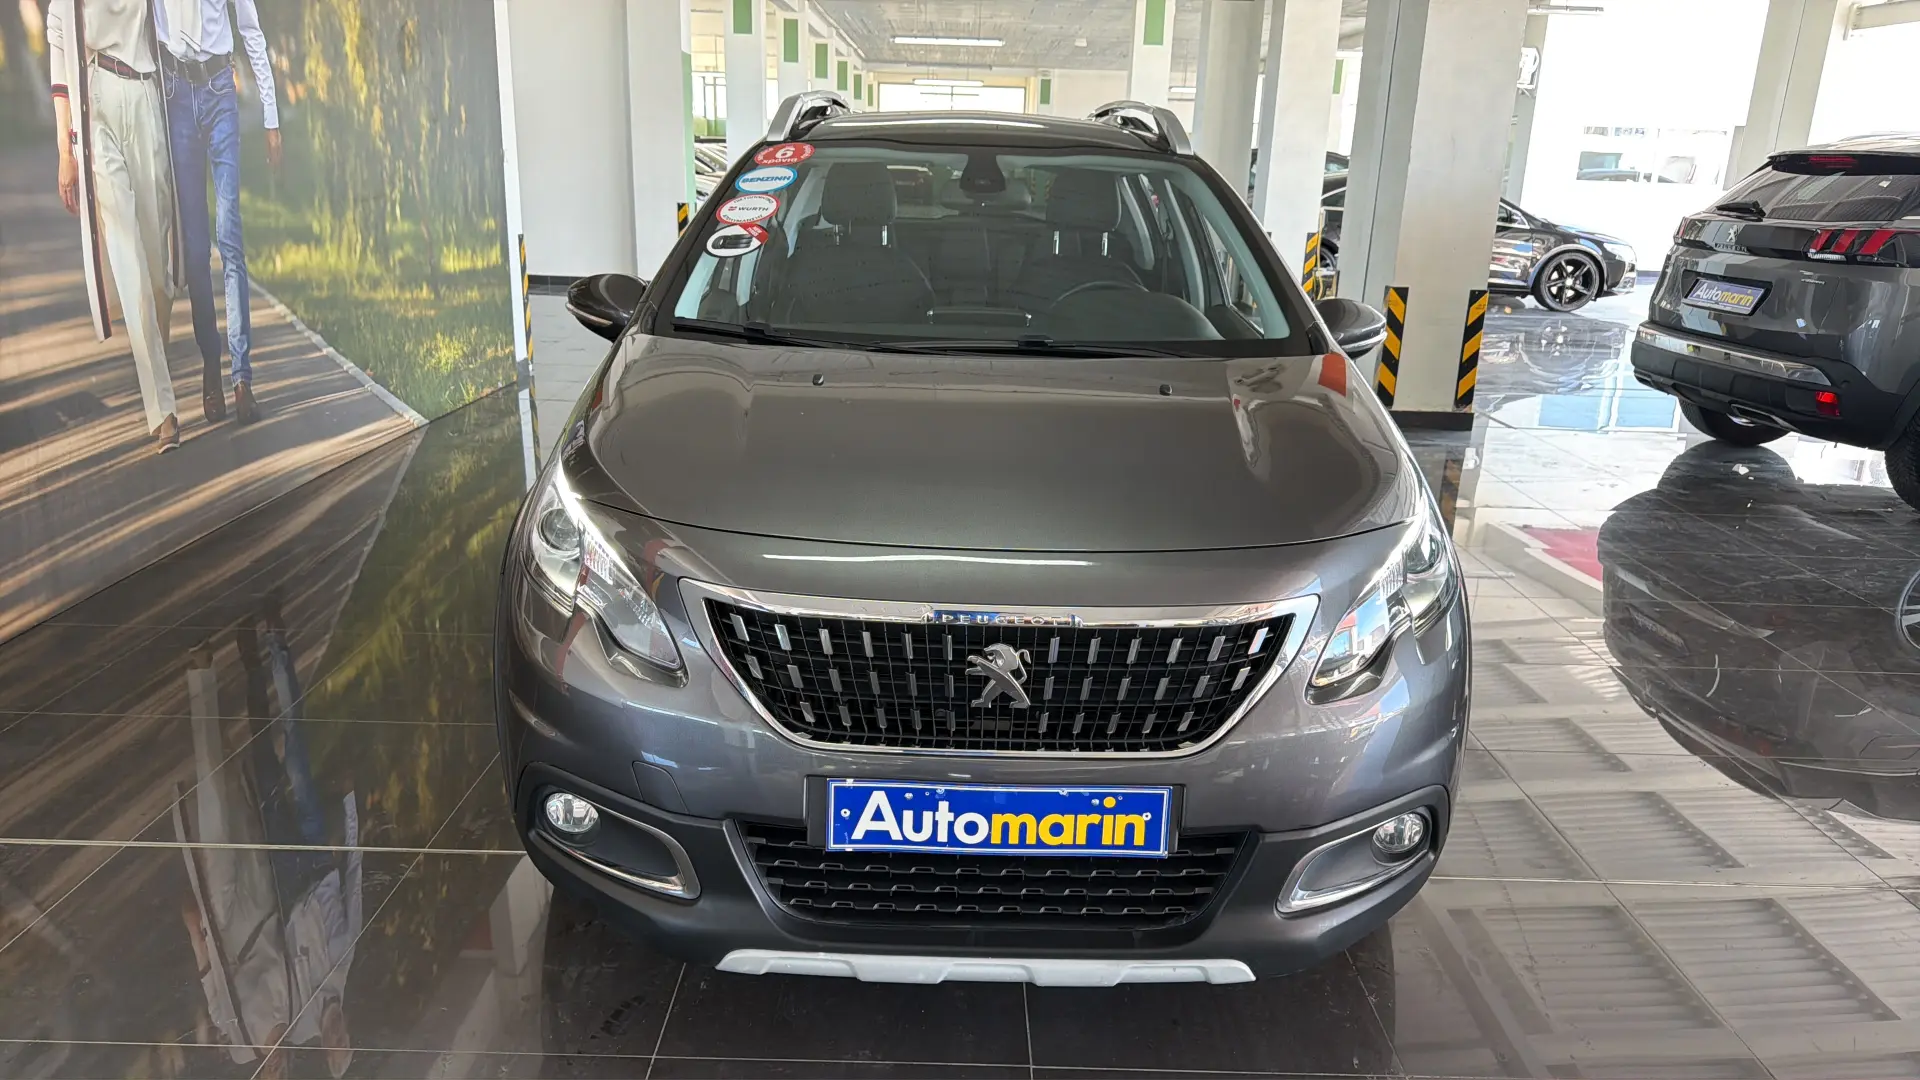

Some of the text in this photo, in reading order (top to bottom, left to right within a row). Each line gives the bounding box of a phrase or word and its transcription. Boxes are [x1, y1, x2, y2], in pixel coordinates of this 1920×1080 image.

[776, 147, 796, 159] 6
[1692, 282, 1754, 307] Automarin
[941, 614, 1063, 626] PEUGEOT
[851, 790, 1146, 846] Automarin
